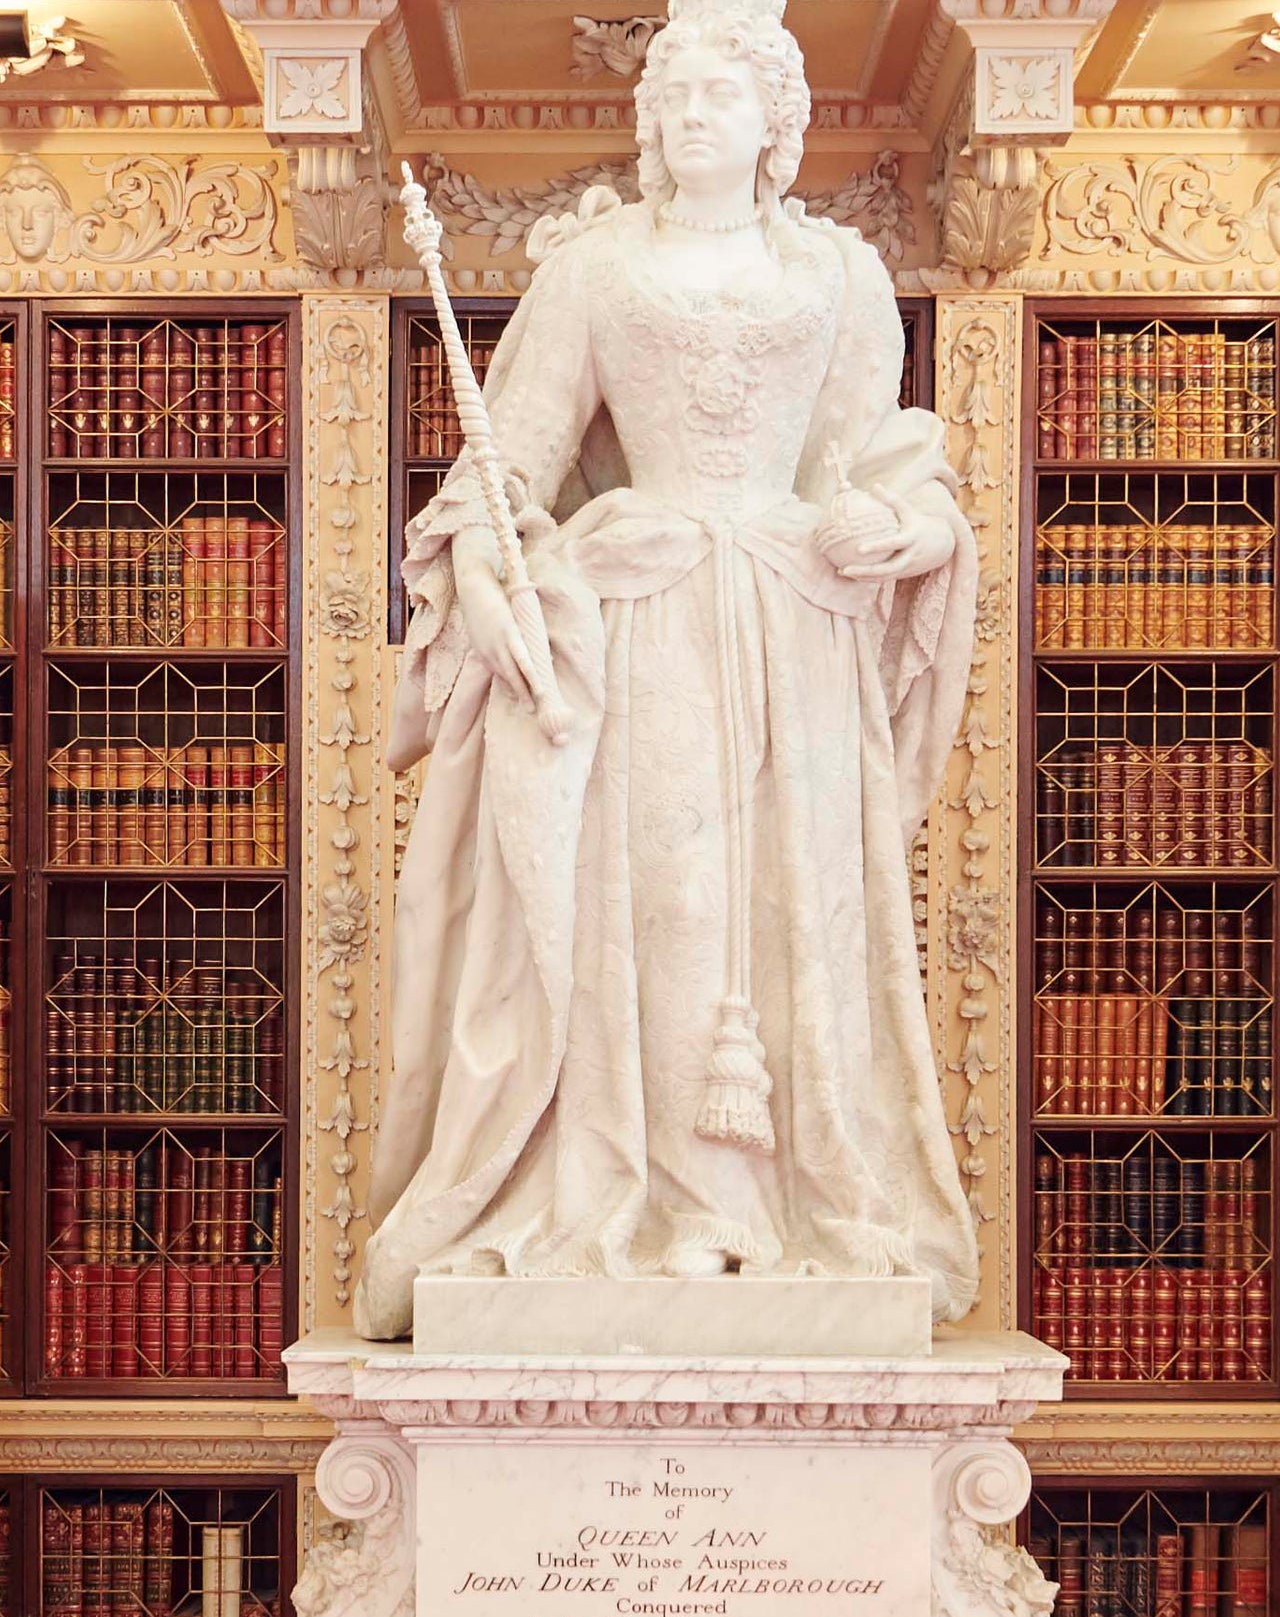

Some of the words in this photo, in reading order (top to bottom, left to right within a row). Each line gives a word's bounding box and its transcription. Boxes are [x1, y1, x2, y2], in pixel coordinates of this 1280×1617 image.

[659, 1457, 686, 1475] To
[604, 1480, 642, 1497] The
[652, 1481, 734, 1504] Memory
[664, 1503, 686, 1520] of
[577, 1525, 678, 1552] QUEEN
[690, 1527, 767, 1548] ANN
[536, 1551, 600, 1569] Under
[611, 1552, 683, 1570] Whose
[697, 1553, 788, 1576] Auspices
[452, 1571, 525, 1595] JOHN
[537, 1572, 620, 1593] DUKE
[637, 1575, 660, 1593] of
[677, 1574, 886, 1595] MARLBOROUGH
